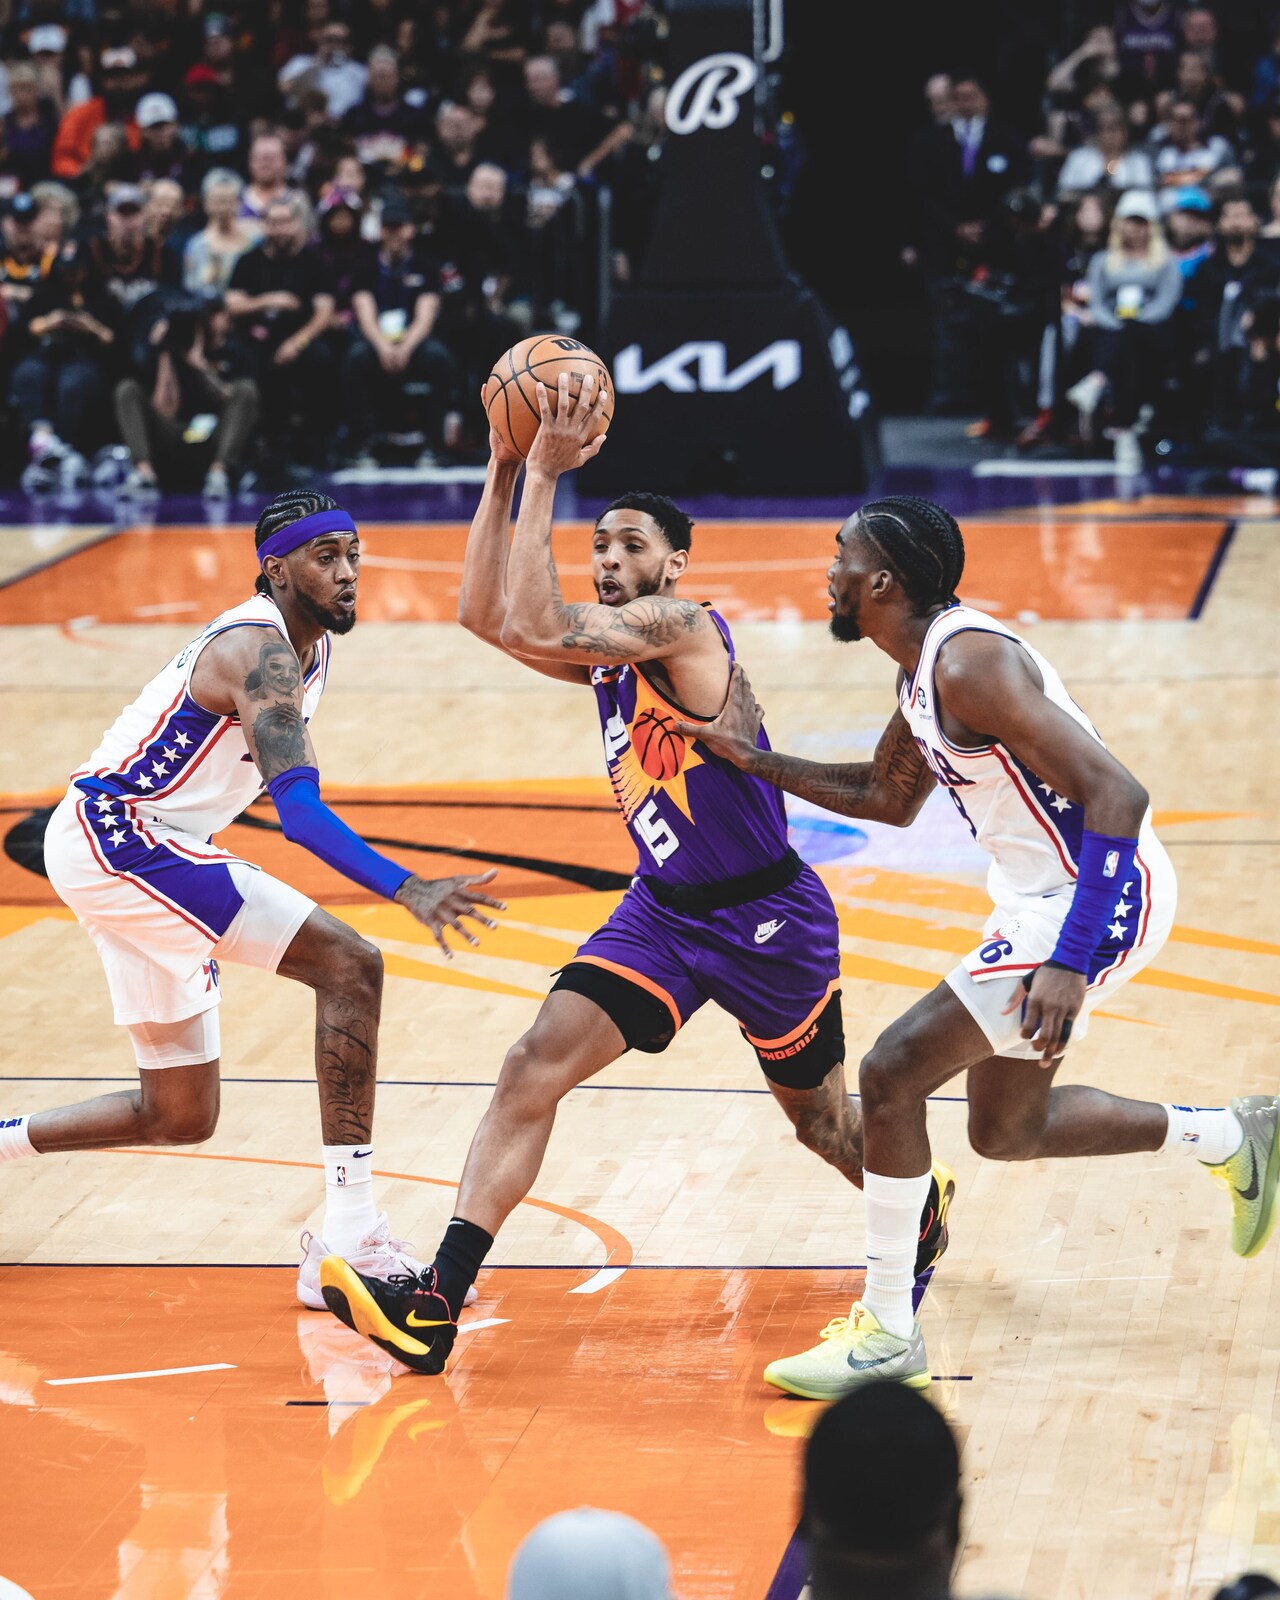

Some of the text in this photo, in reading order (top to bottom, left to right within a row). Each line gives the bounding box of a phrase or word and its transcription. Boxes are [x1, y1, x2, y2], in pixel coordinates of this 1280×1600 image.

[633, 798, 680, 868] 15
[757, 919, 778, 937] NIKE
[978, 931, 1013, 964] 6
[758, 1022, 819, 1061] PHOENIX
